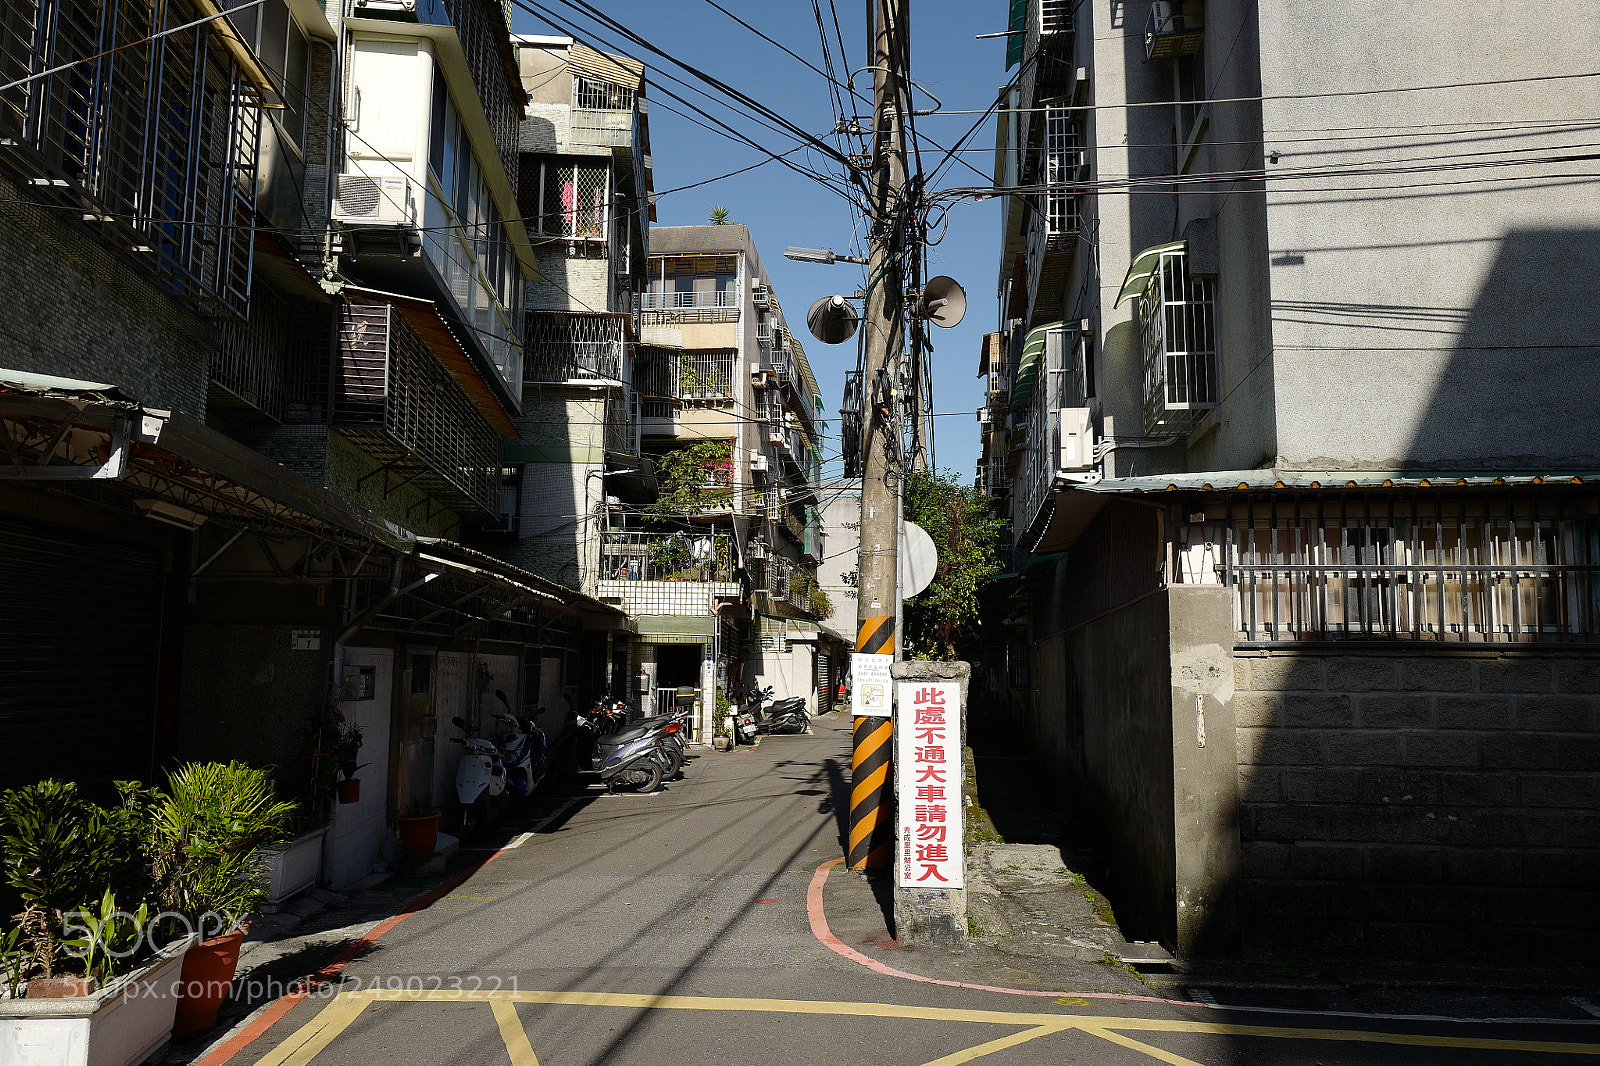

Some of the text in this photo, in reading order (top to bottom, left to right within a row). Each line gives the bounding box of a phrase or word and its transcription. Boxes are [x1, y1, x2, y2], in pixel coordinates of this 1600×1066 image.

[913, 687, 949, 883] 此處不通大車請勿進入
